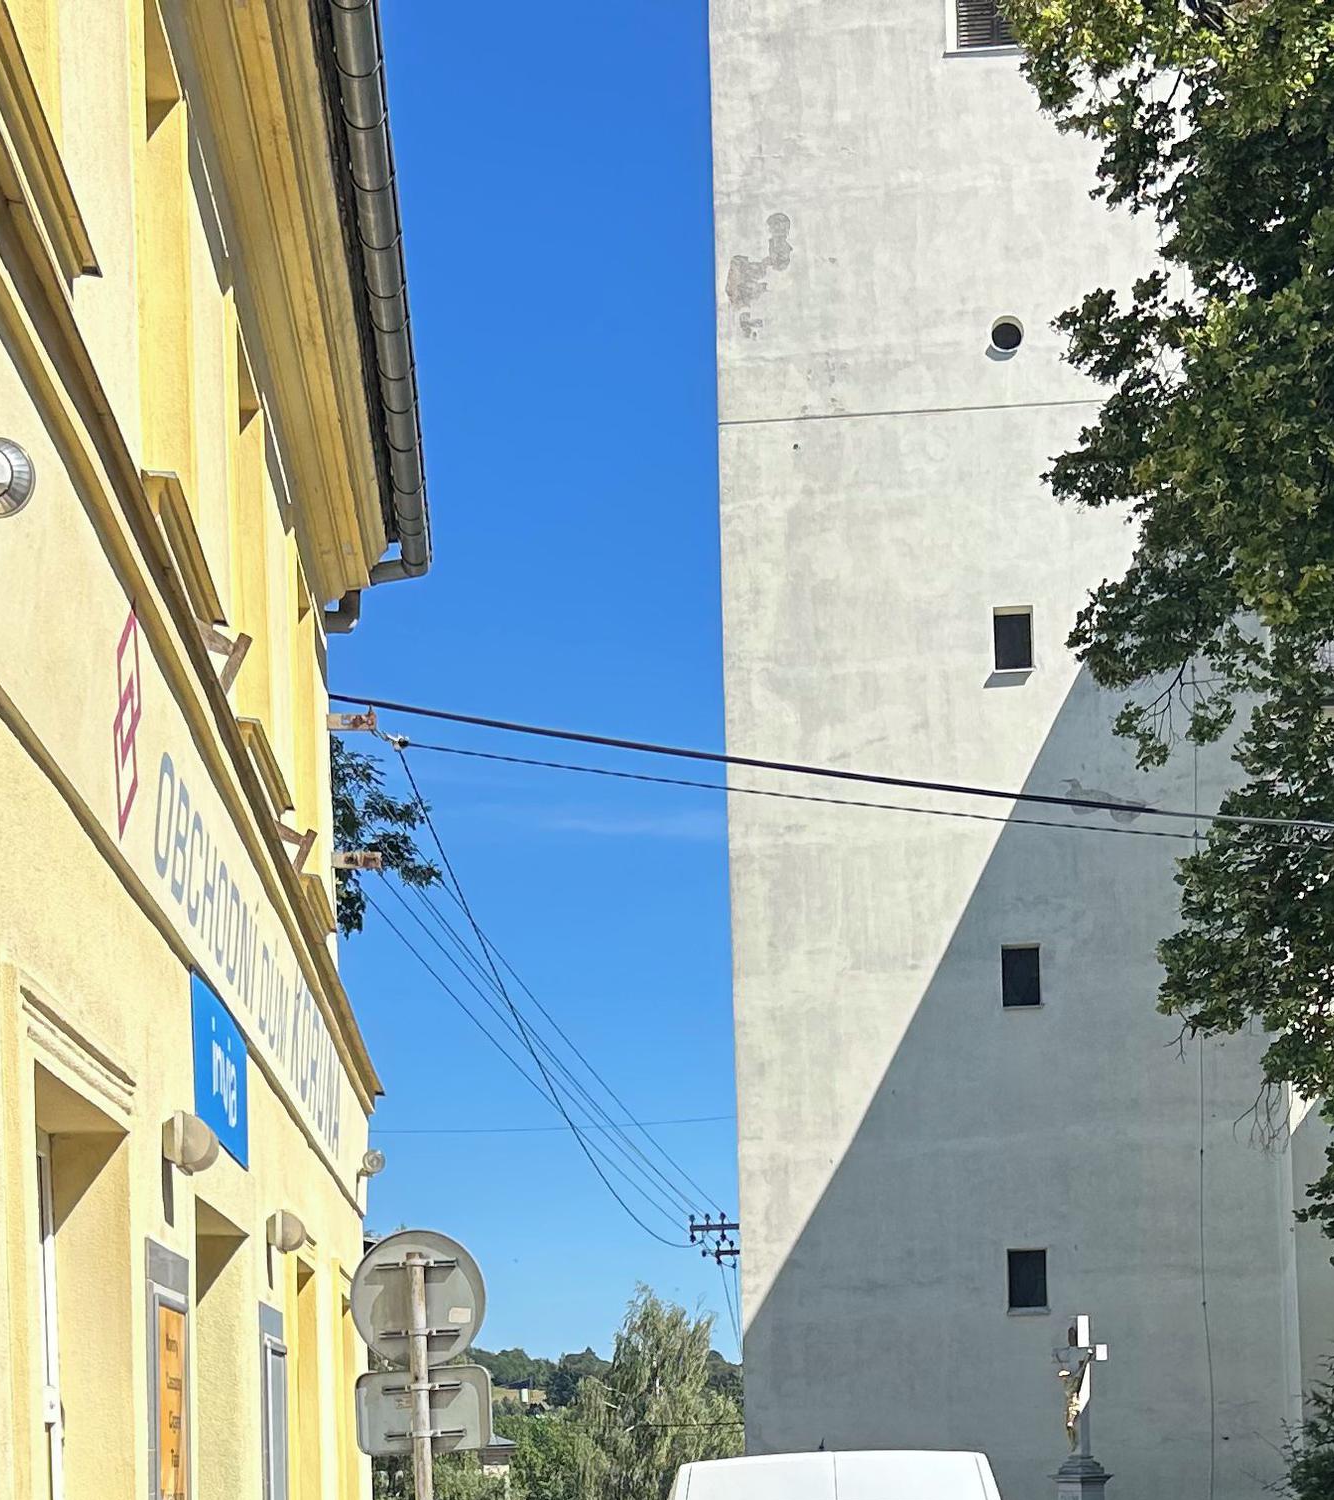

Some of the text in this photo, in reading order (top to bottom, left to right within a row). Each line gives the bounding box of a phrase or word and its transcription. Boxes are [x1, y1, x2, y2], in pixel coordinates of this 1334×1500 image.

[154, 751, 260, 1014] OBCHODNÍ
[290, 962, 341, 1159] KORUNA
[211, 1015, 238, 1128] invia
